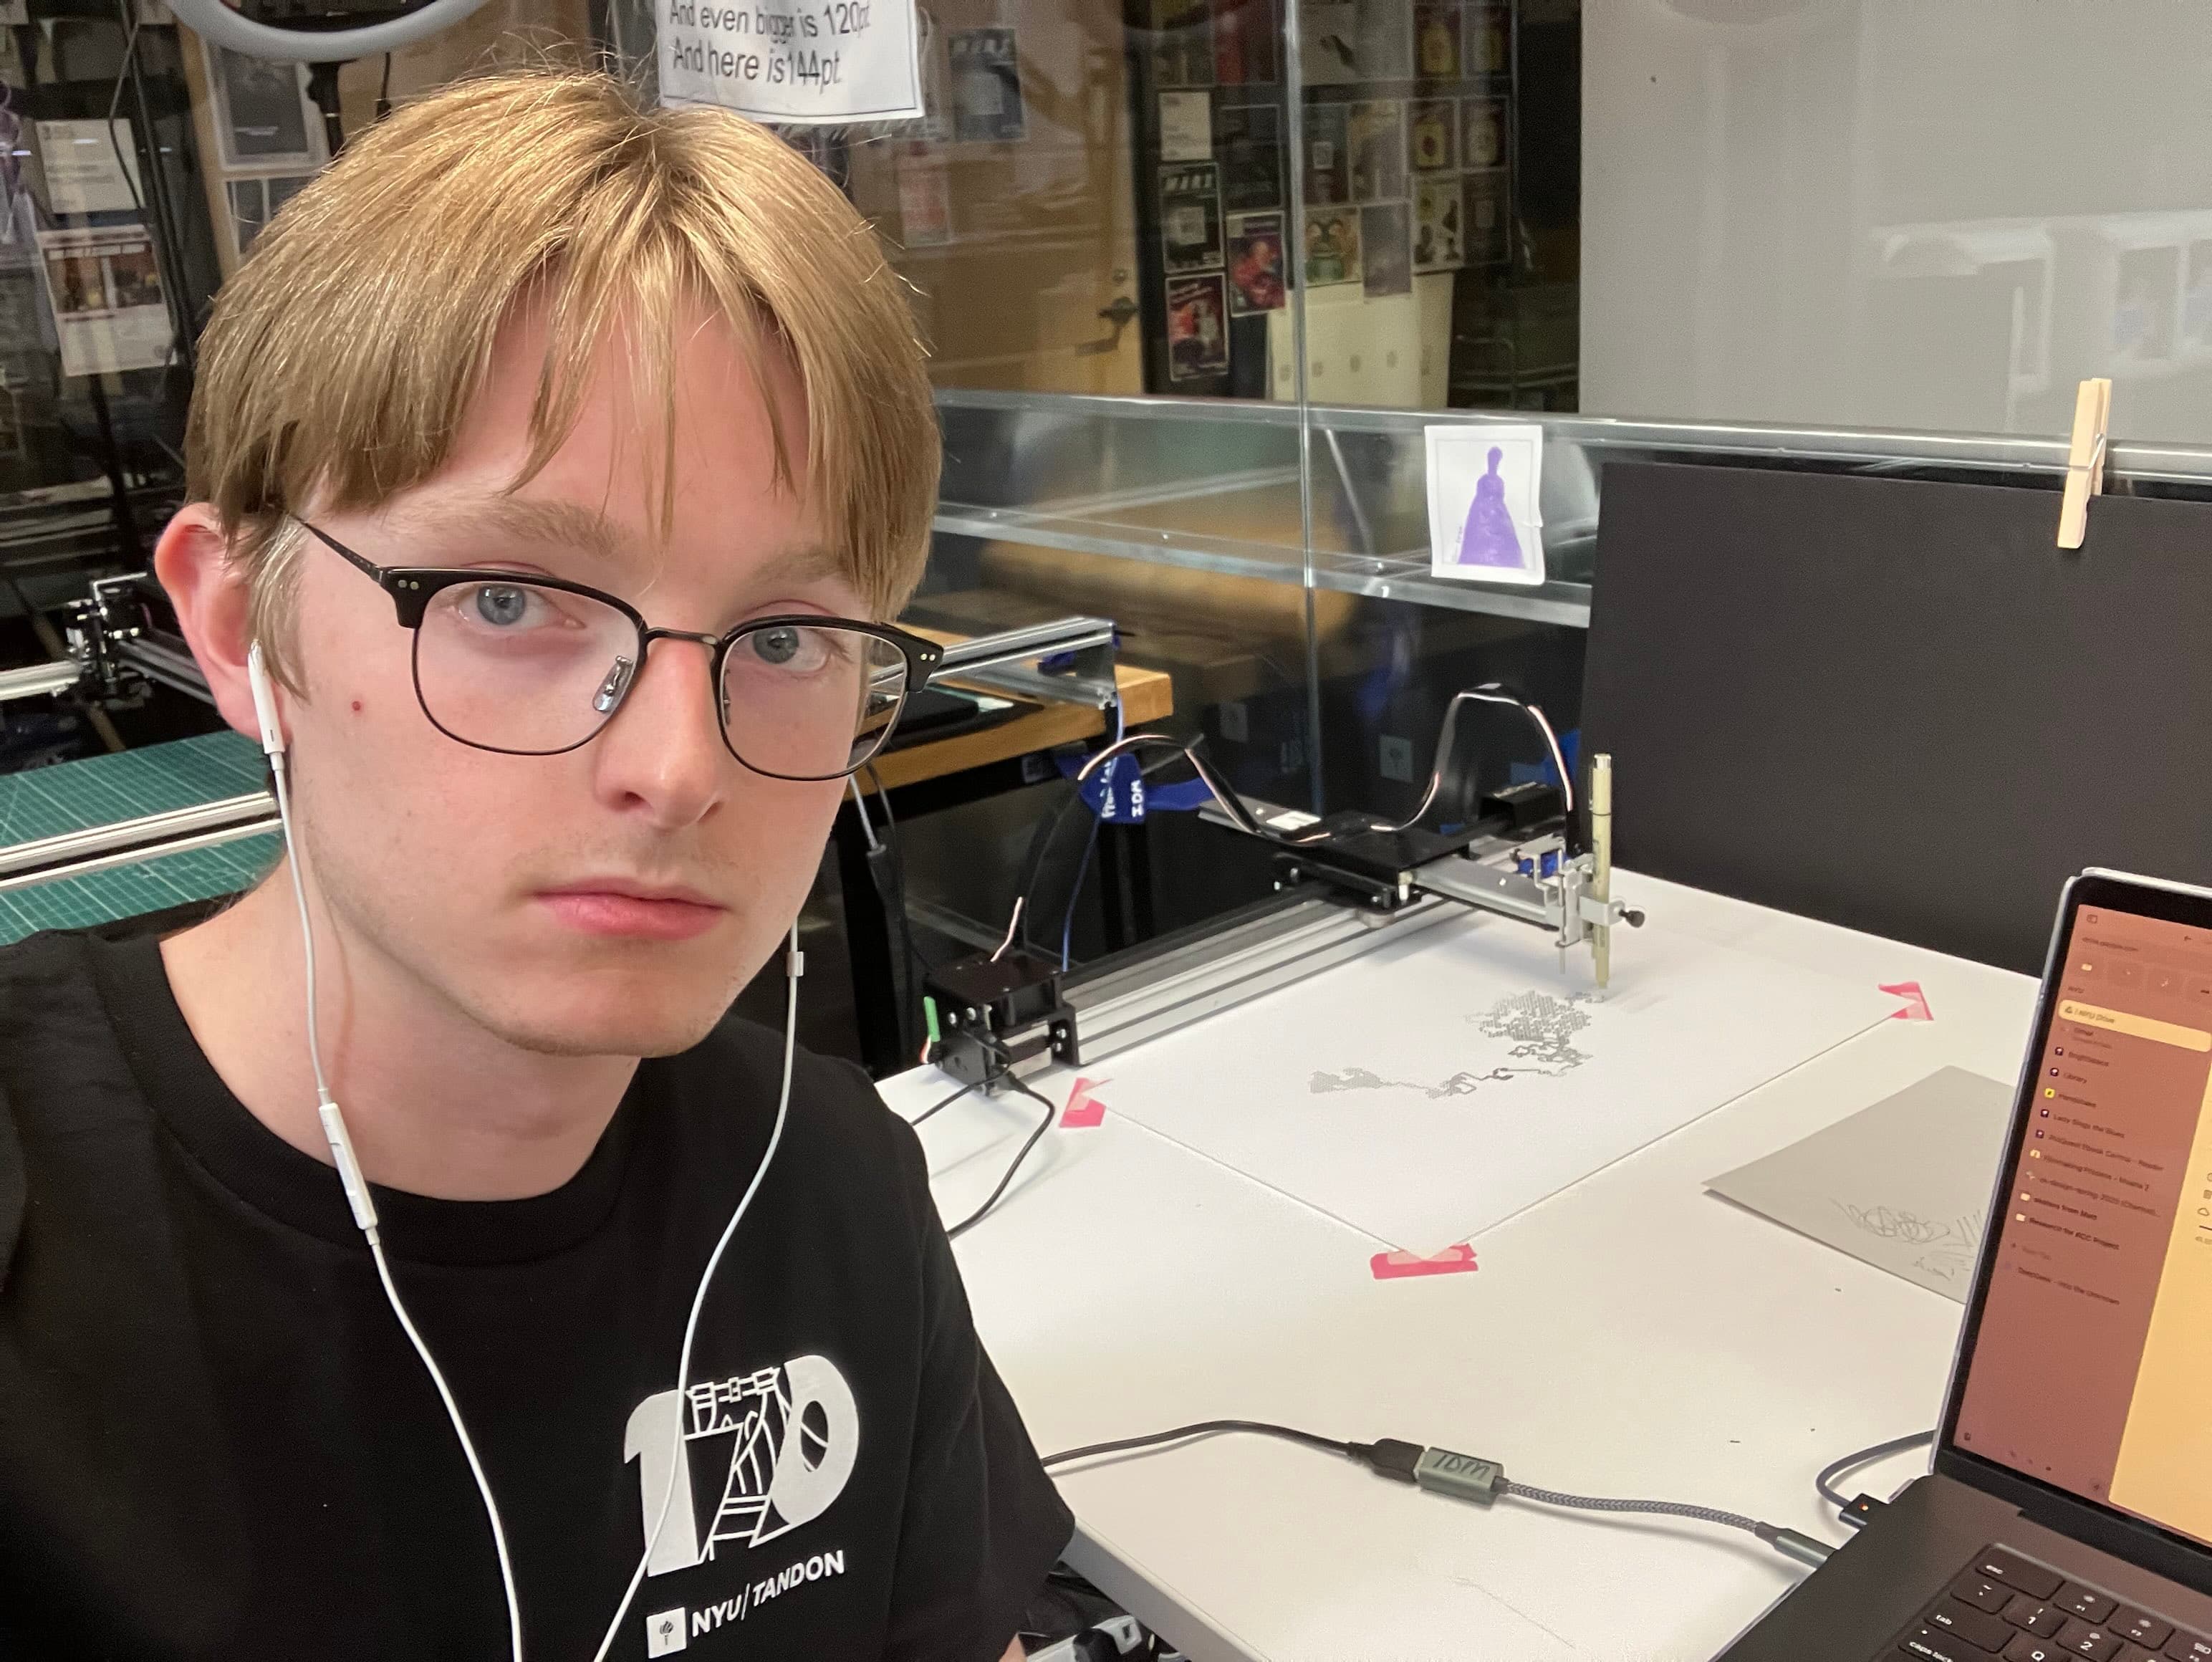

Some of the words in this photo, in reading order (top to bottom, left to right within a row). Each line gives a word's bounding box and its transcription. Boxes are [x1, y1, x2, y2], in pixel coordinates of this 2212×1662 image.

[669, 0, 695, 27] And
[700, 6, 749, 34] even
[797, 7, 818, 37] is
[672, 36, 703, 72] And
[708, 39, 759, 80] here
[2031, 1650, 2045, 1661] Q
[2079, 1641, 2094, 1651] 2
